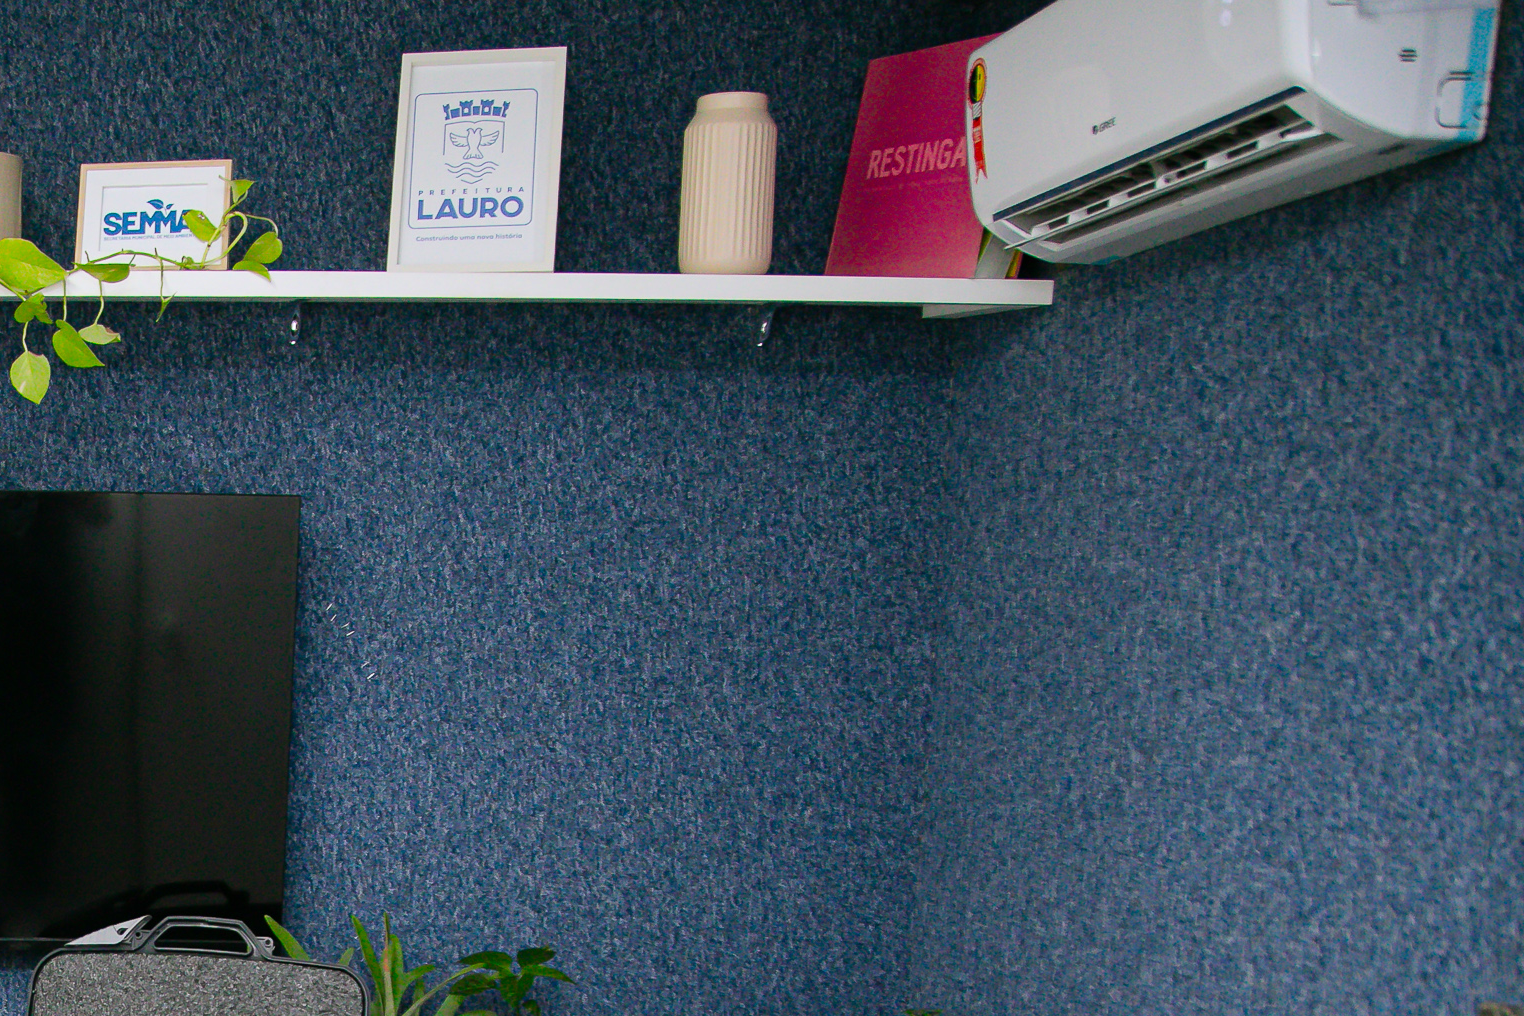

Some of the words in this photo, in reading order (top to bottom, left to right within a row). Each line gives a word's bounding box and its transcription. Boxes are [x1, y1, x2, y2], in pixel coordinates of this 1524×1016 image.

[866, 136, 967, 180] RESTINGA
[418, 186, 524, 196] PREFEITURA
[417, 196, 524, 220] LAURO
[416, 234, 458, 242] Construindo
